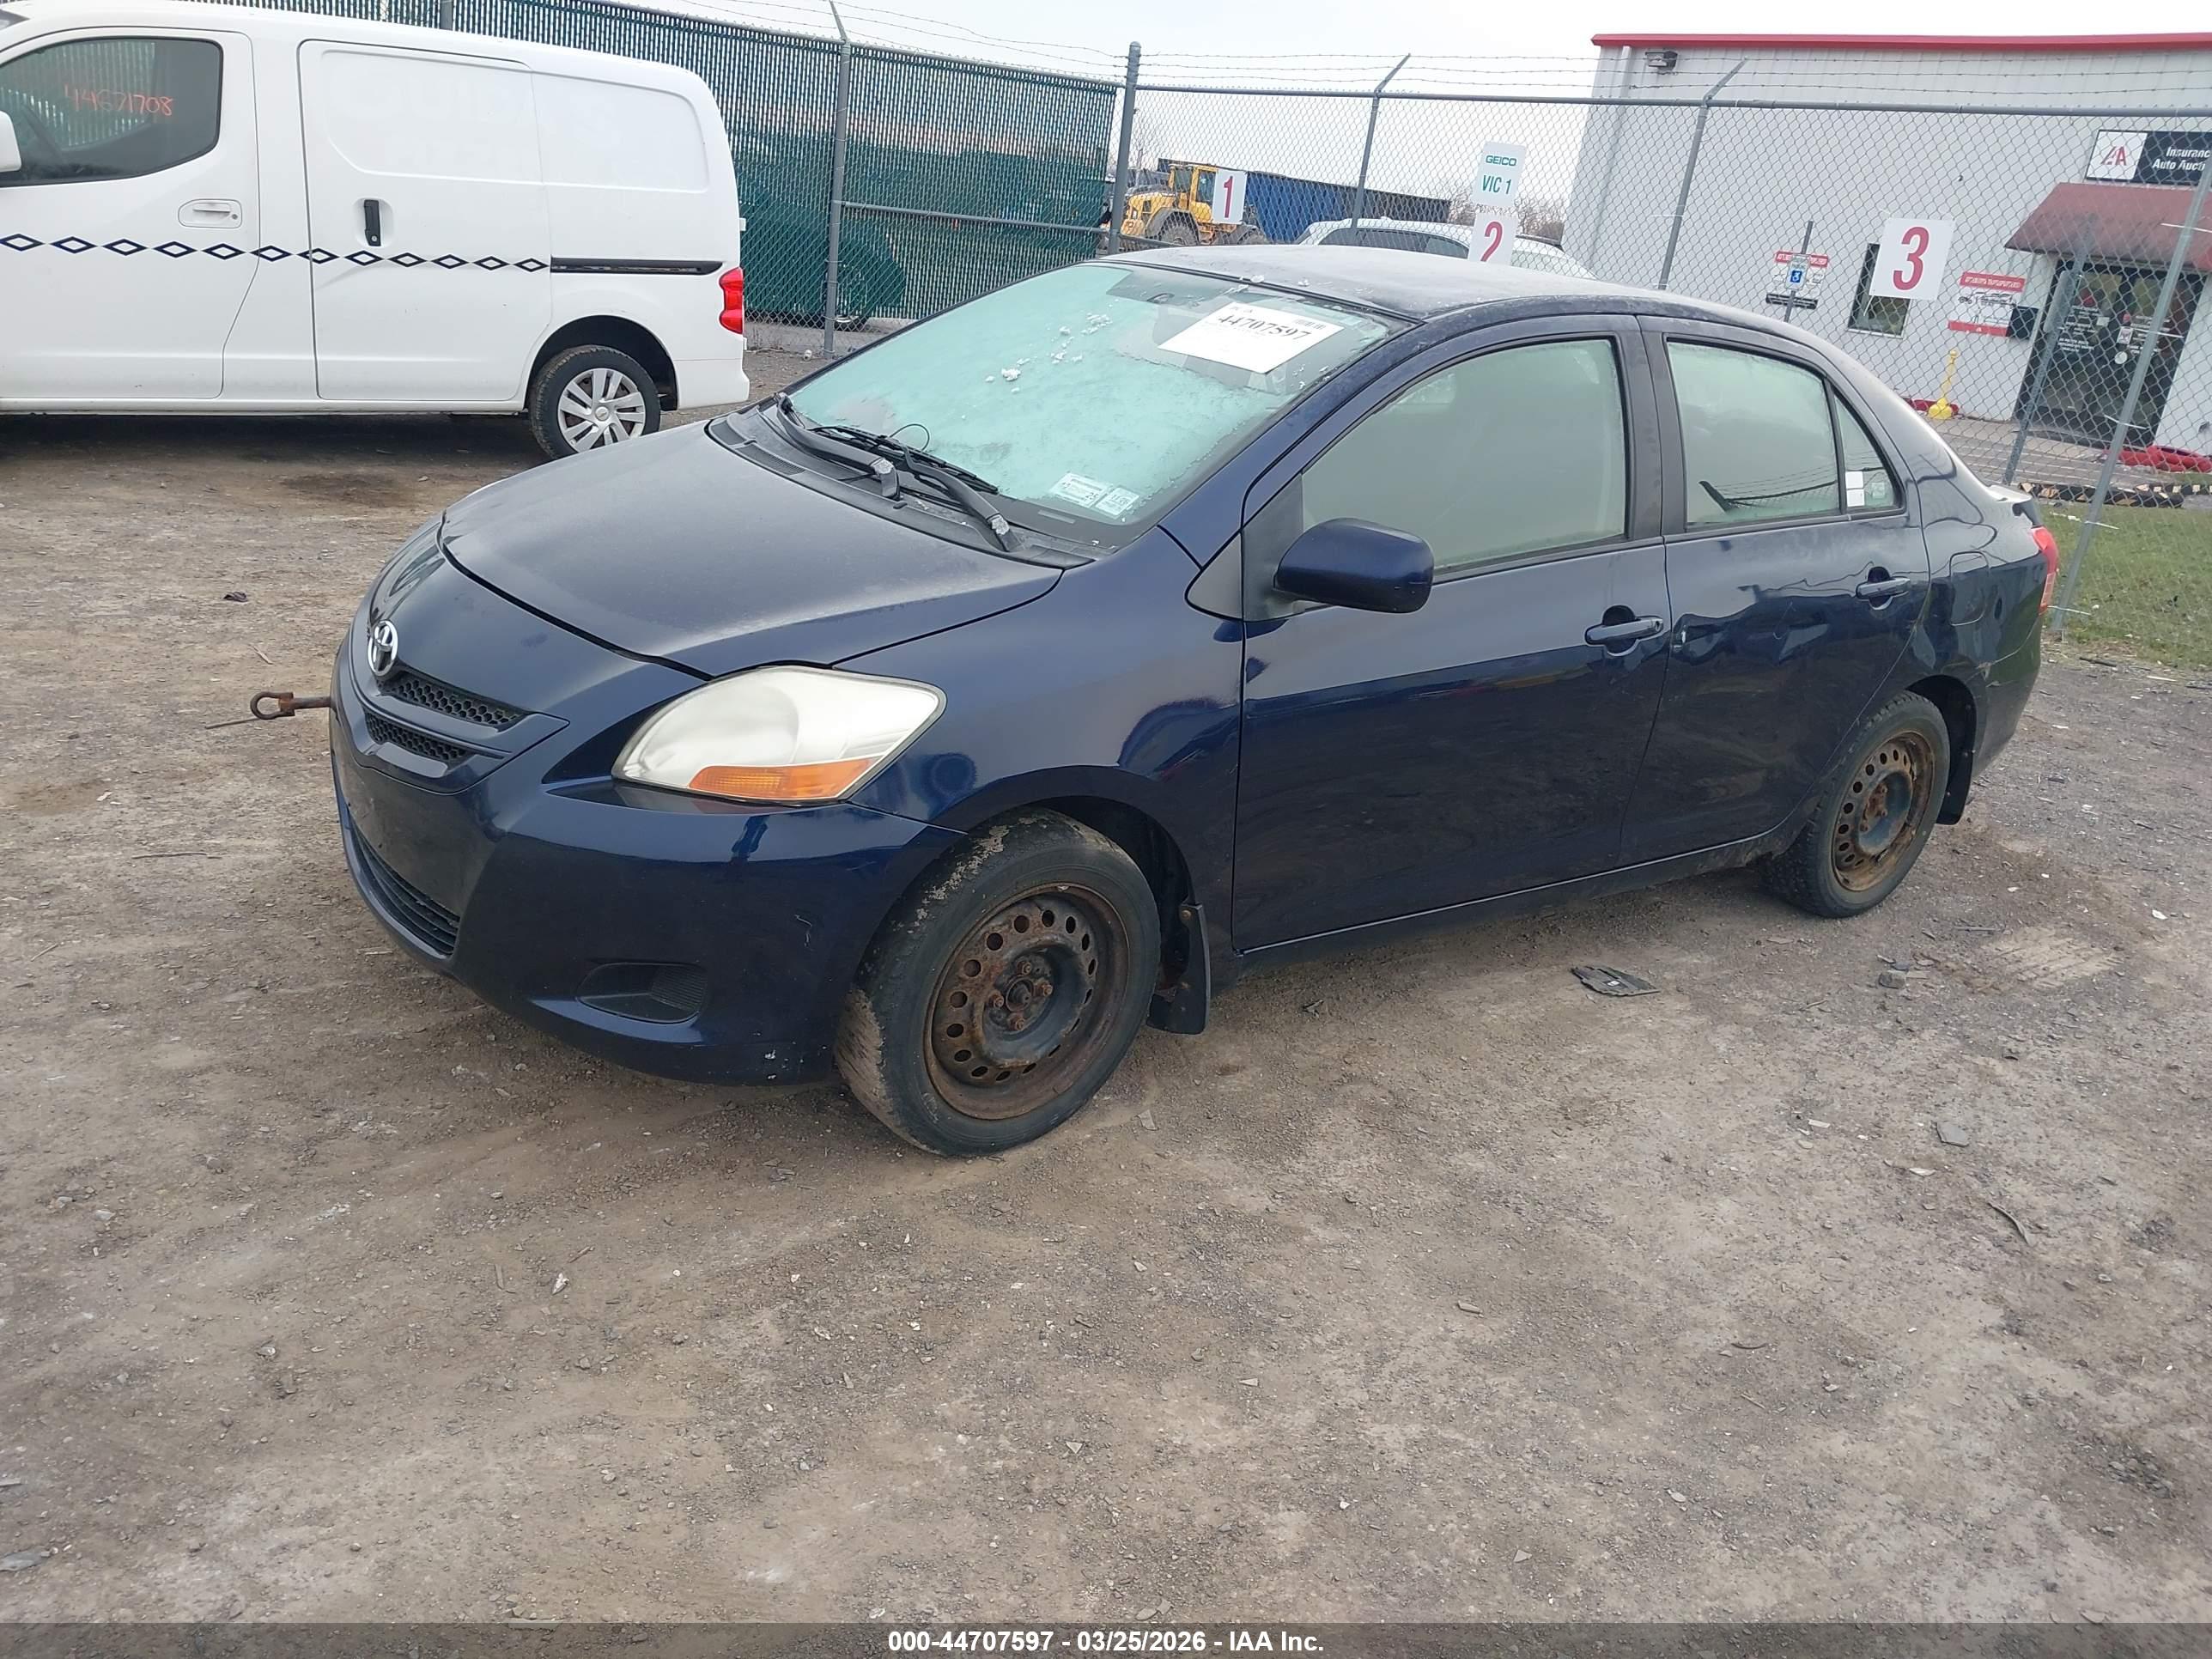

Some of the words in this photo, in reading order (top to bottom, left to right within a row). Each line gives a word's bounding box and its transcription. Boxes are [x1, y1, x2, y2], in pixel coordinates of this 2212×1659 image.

[1486, 155, 1517, 167] GEICO
[2152, 158, 2177, 170] Auto
[2166, 146, 2211, 158] Insuranc
[1224, 175, 1233, 218] 1
[1482, 174, 1502, 193] VIC
[1505, 179, 1512, 195] 1
[1480, 221, 1503, 262] 2
[1893, 226, 1929, 290] 3
[1218, 313, 1311, 340] 44707597
